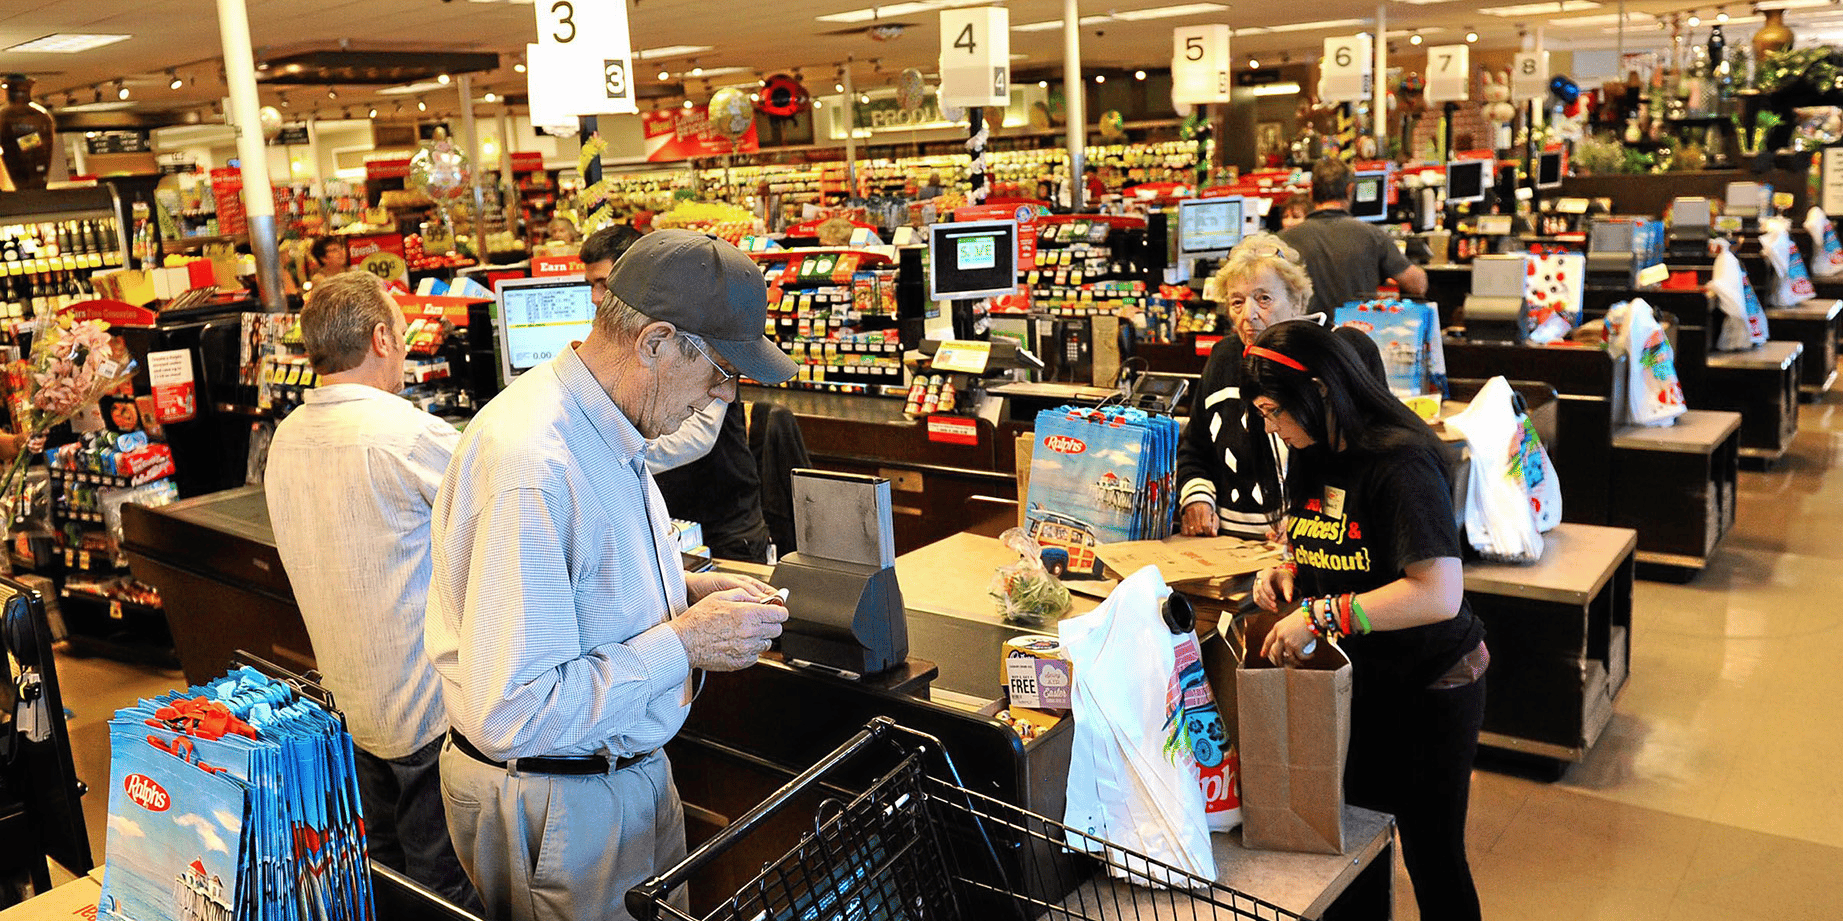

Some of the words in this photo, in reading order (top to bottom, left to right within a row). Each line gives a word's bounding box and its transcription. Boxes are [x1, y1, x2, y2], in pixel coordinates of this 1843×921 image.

[551, 1, 576, 43] 3
[954, 23, 976, 54] 4
[1186, 36, 1204, 61] 5
[1335, 46, 1351, 67] 6
[1439, 54, 1451, 72] 7
[1523, 58, 1536, 75] 8
[605, 64, 625, 94] 3
[995, 71, 1005, 91] 4
[872, 107, 943, 127] PRODU
[540, 262, 567, 271] Earn
[569, 261, 586, 270] Fre
[532, 351, 552, 360] 0.00
[1048, 436, 1083, 453] Ralphs
[1347, 521, 1362, 539] &
[1010, 679, 1036, 694] FREE
[127, 774, 167, 808] Ralphs
